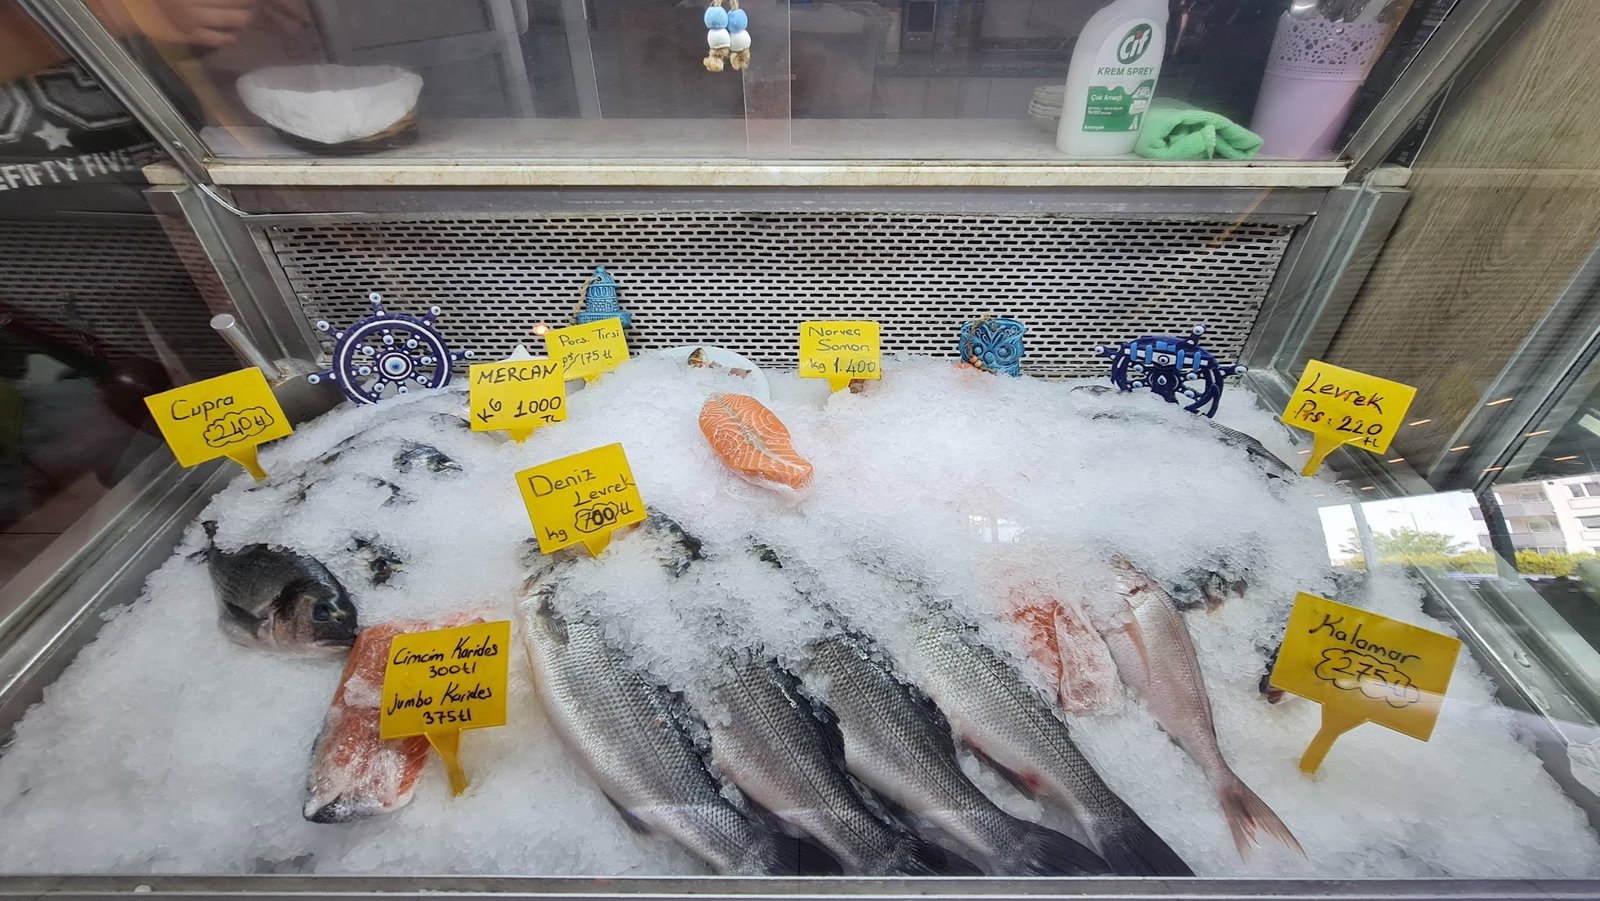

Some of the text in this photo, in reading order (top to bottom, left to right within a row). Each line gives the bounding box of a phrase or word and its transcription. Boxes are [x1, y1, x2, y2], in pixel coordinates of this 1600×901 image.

[1120, 29, 1150, 60] Cif
[1097, 67, 1154, 76] KREM SPREY
[816, 338, 870, 352] Somon
[477, 362, 558, 385] MERCAN
[809, 358, 827, 374] kg
[1302, 372, 1384, 415] Levrek
[513, 396, 562, 418] 1000
[540, 414, 562, 423] TL
[1335, 415, 1384, 436] 220
[527, 468, 598, 498] Deniz
[573, 473, 637, 508] Levrek
[544, 526, 569, 543] kg
[392, 634, 499, 666] Cimcim Karides
[1308, 613, 1422, 665] Kalamar
[440, 681, 493, 706] Karides
